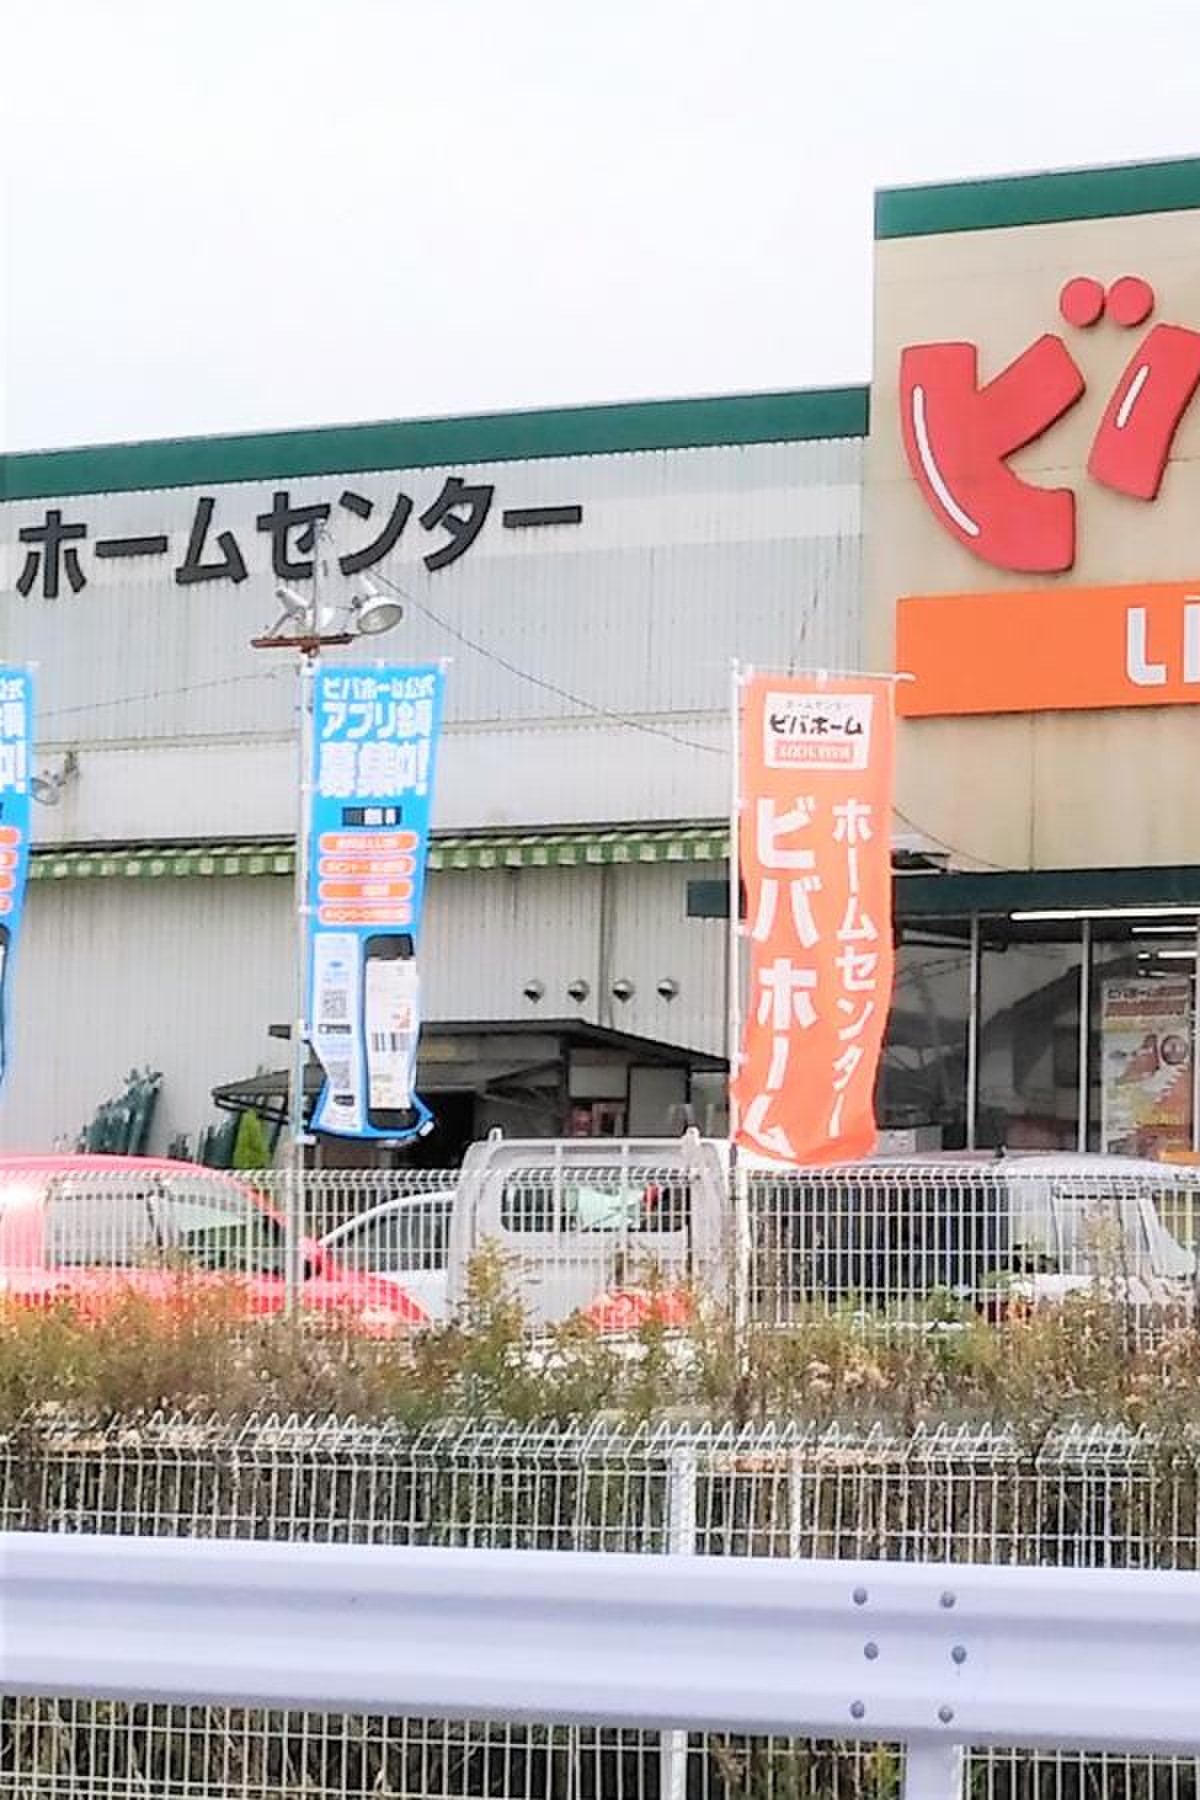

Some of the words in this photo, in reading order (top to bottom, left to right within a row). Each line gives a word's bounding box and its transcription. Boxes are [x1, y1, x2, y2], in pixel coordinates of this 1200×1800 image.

[16, 477, 582, 599] ホームセンター
[769, 714, 864, 735] ビバホーム
[742, 796, 823, 1158] ビバホーム
[831, 799, 878, 1139] ホームセンター
